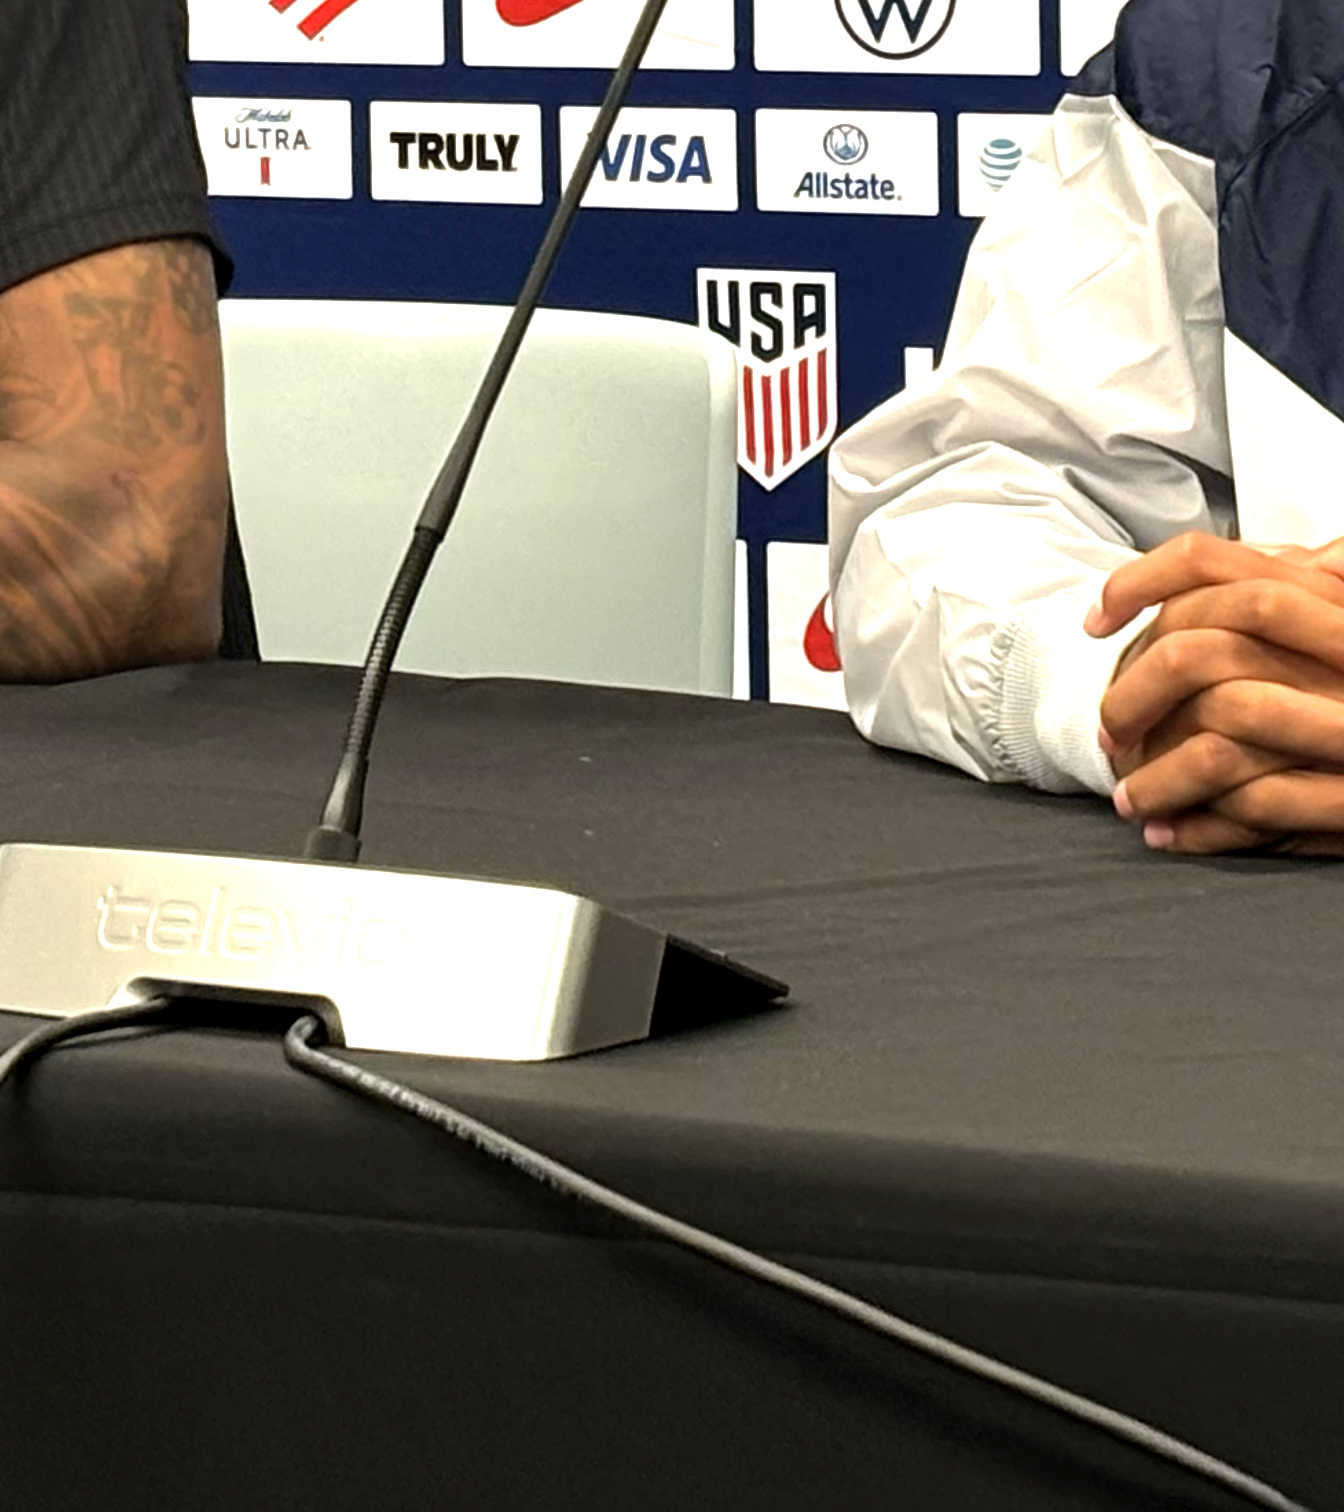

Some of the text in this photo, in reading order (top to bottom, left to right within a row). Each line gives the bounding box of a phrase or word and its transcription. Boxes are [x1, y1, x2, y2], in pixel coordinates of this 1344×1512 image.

[225, 128, 310, 150] ULTRA
[390, 132, 520, 172] TRULY
[600, 134, 712, 183] VISA
[707, 280, 826, 362] USA
